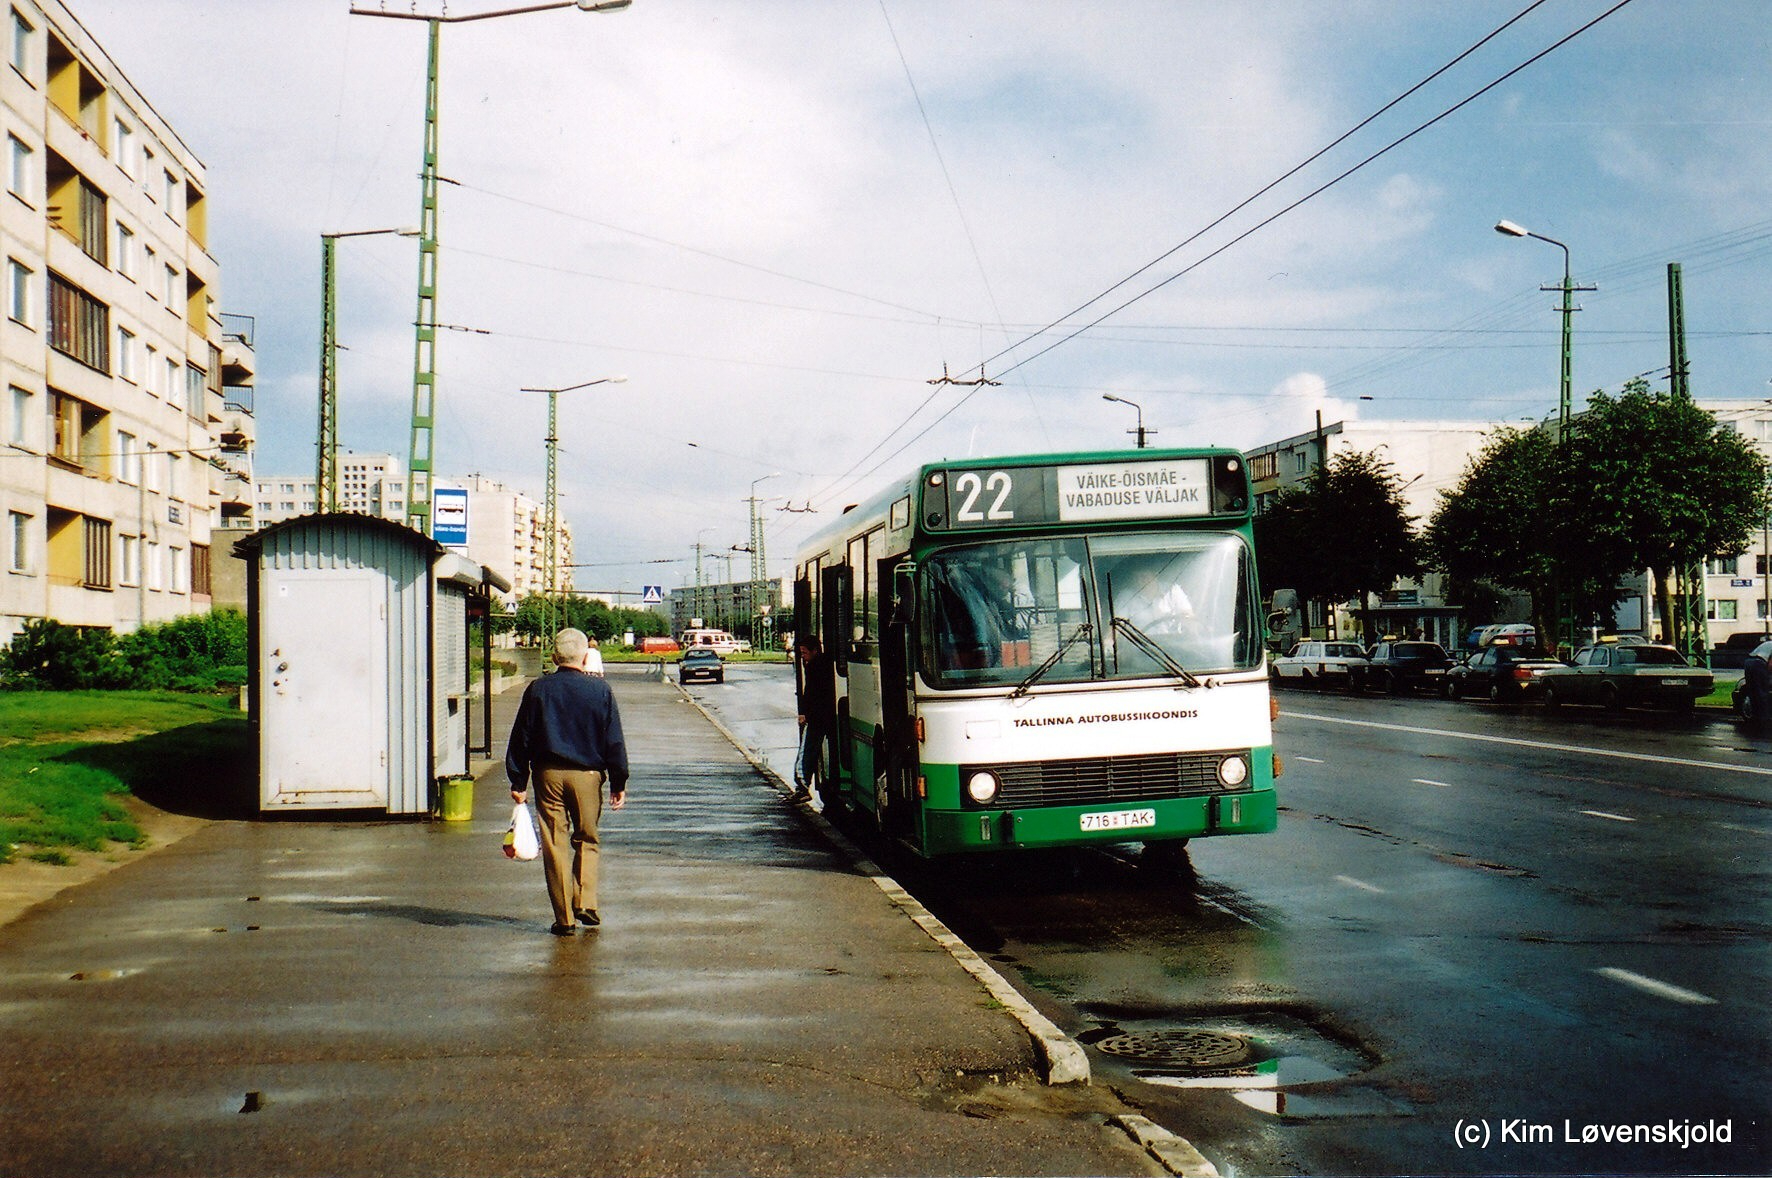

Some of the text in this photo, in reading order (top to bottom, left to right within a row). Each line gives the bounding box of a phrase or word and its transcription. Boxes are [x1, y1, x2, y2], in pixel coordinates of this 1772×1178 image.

[956, 471, 1014, 522] 22
[1066, 487, 1199, 508] VABADUSE VÄLJAK
[1013, 709, 1198, 728] TALLINNA AUTOBUSSIKOONDIS
[1086, 812, 1149, 828] 716 TAK
